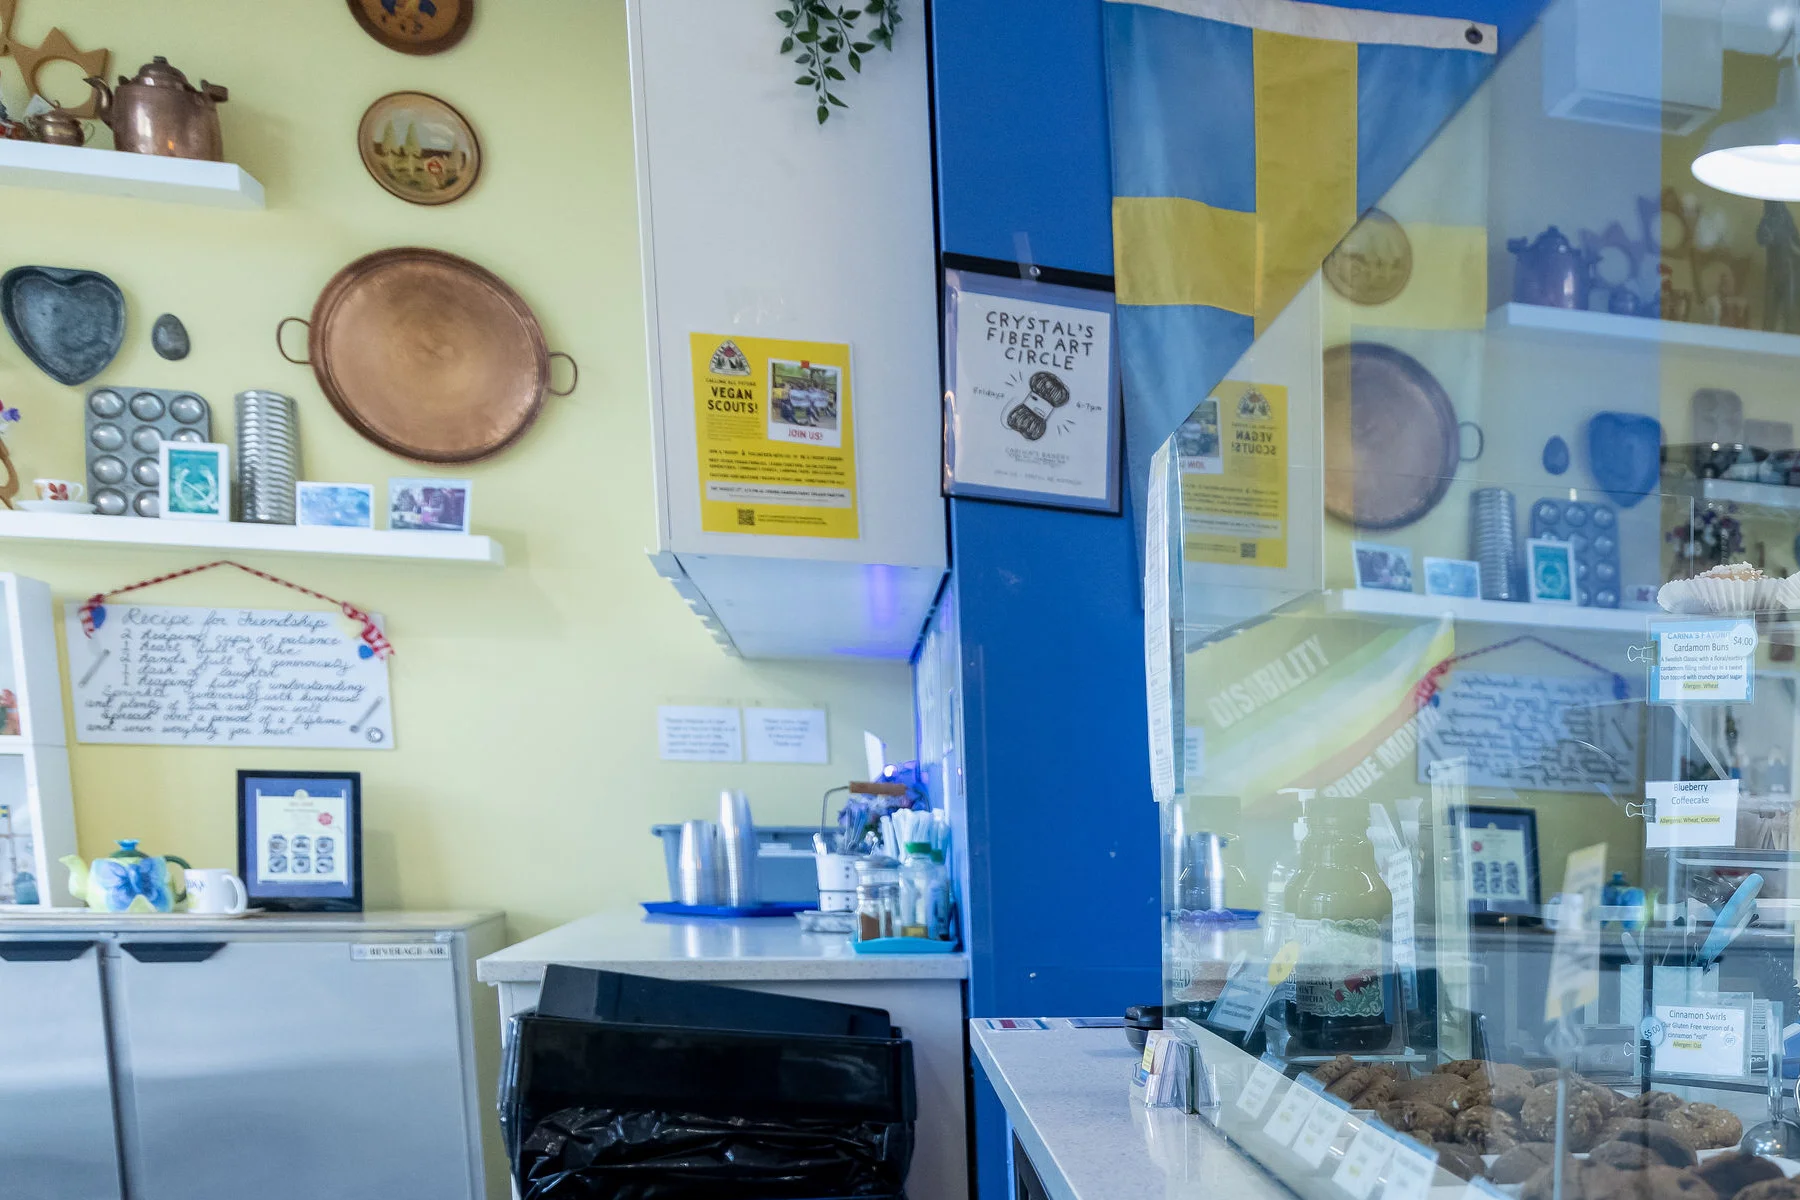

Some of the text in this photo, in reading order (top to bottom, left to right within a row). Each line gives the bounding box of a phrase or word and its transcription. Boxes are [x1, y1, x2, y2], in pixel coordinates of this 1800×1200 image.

[986, 327, 1094, 356] FIBER ART
[1004, 347, 1075, 371] CIRCLE
[711, 386, 753, 400] VEGAN
[707, 400, 758, 414] SCOUTS!
[788, 429, 807, 439] JOIN
[122, 607, 195, 628] Recipe
[202, 609, 229, 628] for
[1674, 643, 1729, 652] Cardamom Buns
[1674, 783, 1708, 792] Blueberry
[1671, 796, 1709, 805] Coffeecake
[1669, 1010, 1727, 1021] Cinnamon Swirls
